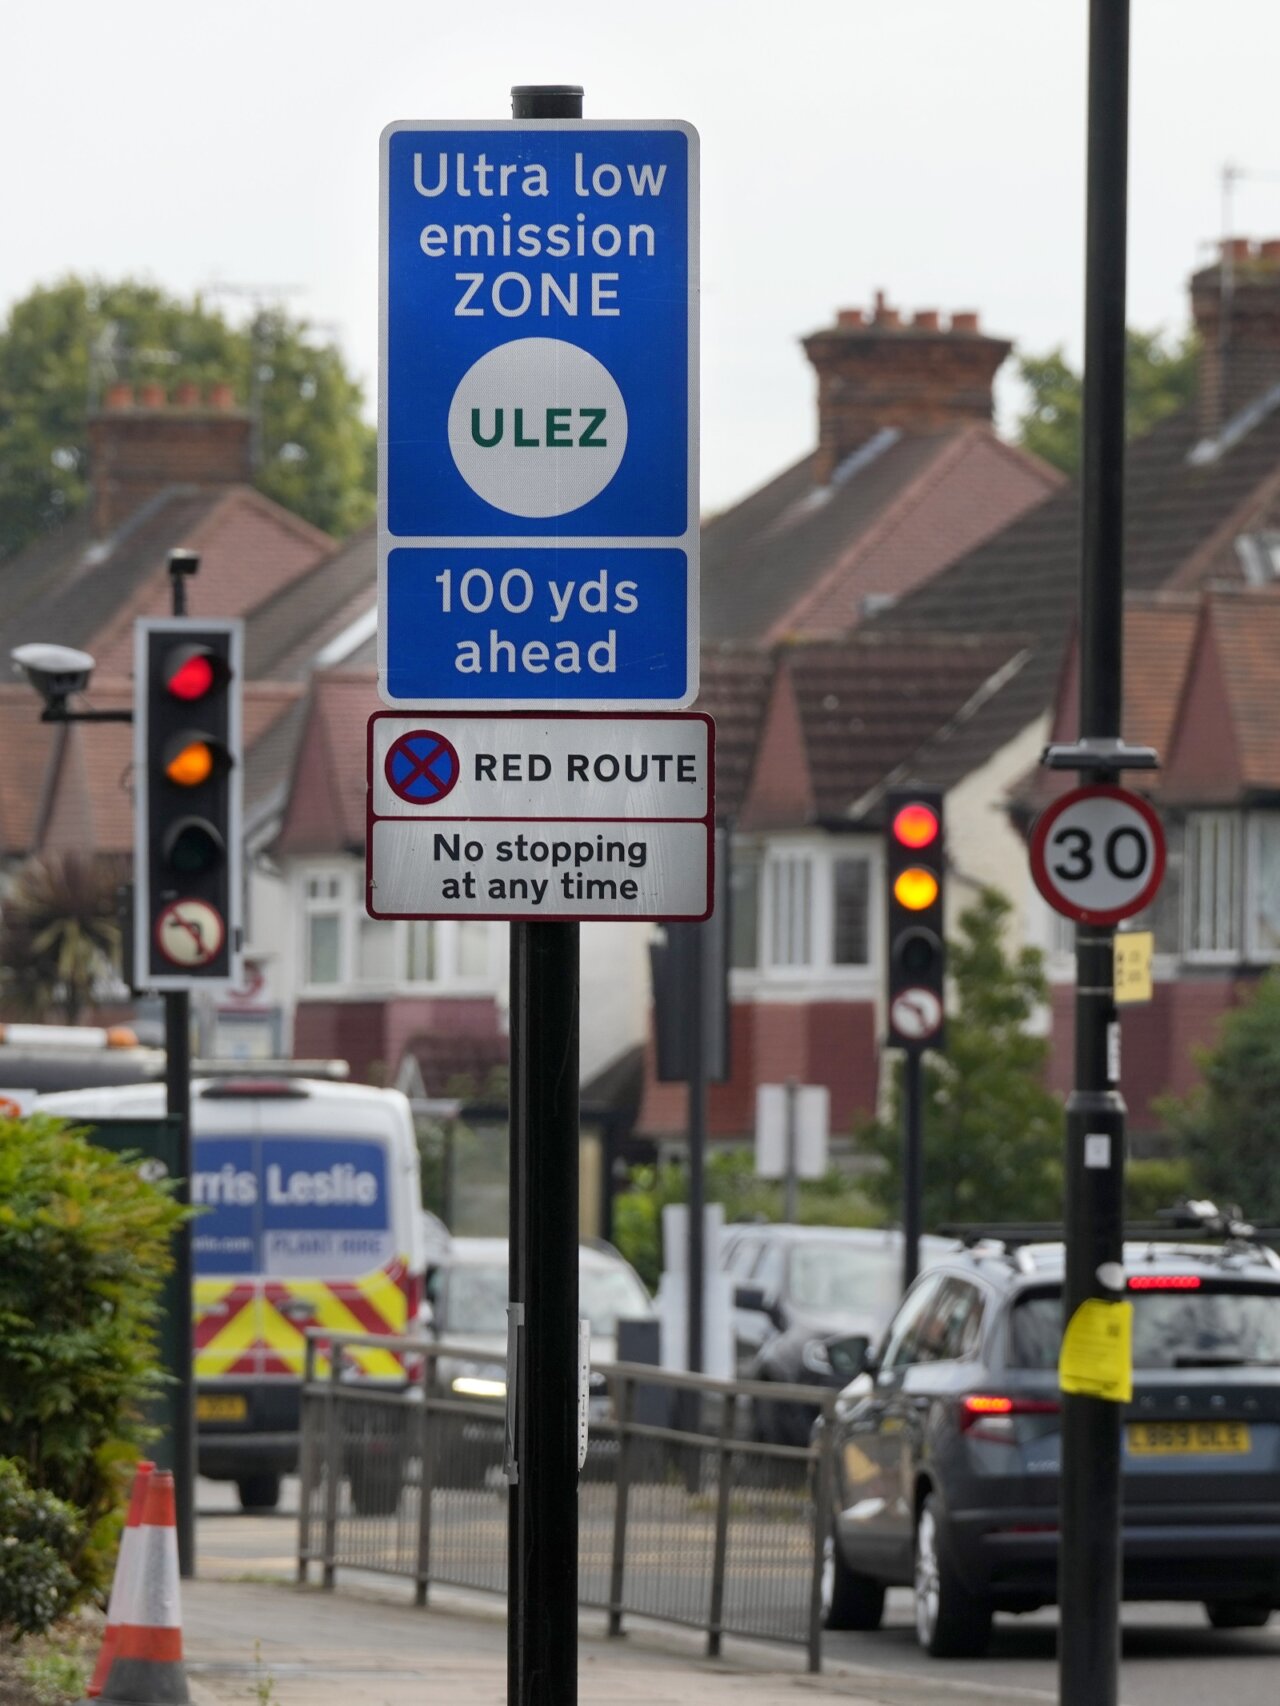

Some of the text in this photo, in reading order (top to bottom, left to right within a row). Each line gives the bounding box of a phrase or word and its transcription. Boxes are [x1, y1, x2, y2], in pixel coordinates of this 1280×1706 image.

[413, 152, 667, 198] Ultra low
[420, 213, 655, 257] emission
[454, 272, 620, 317] ZONE
[471, 408, 607, 447] ULEZ
[435, 568, 638, 623] 100 yds
[455, 629, 617, 674] ahead
[475, 754, 697, 782] RED ROUTE
[433, 834, 647, 867] No stopping
[1053, 826, 1147, 881] 30
[442, 872, 638, 905] at any time
[193, 1162, 377, 1206] rris Leslie
